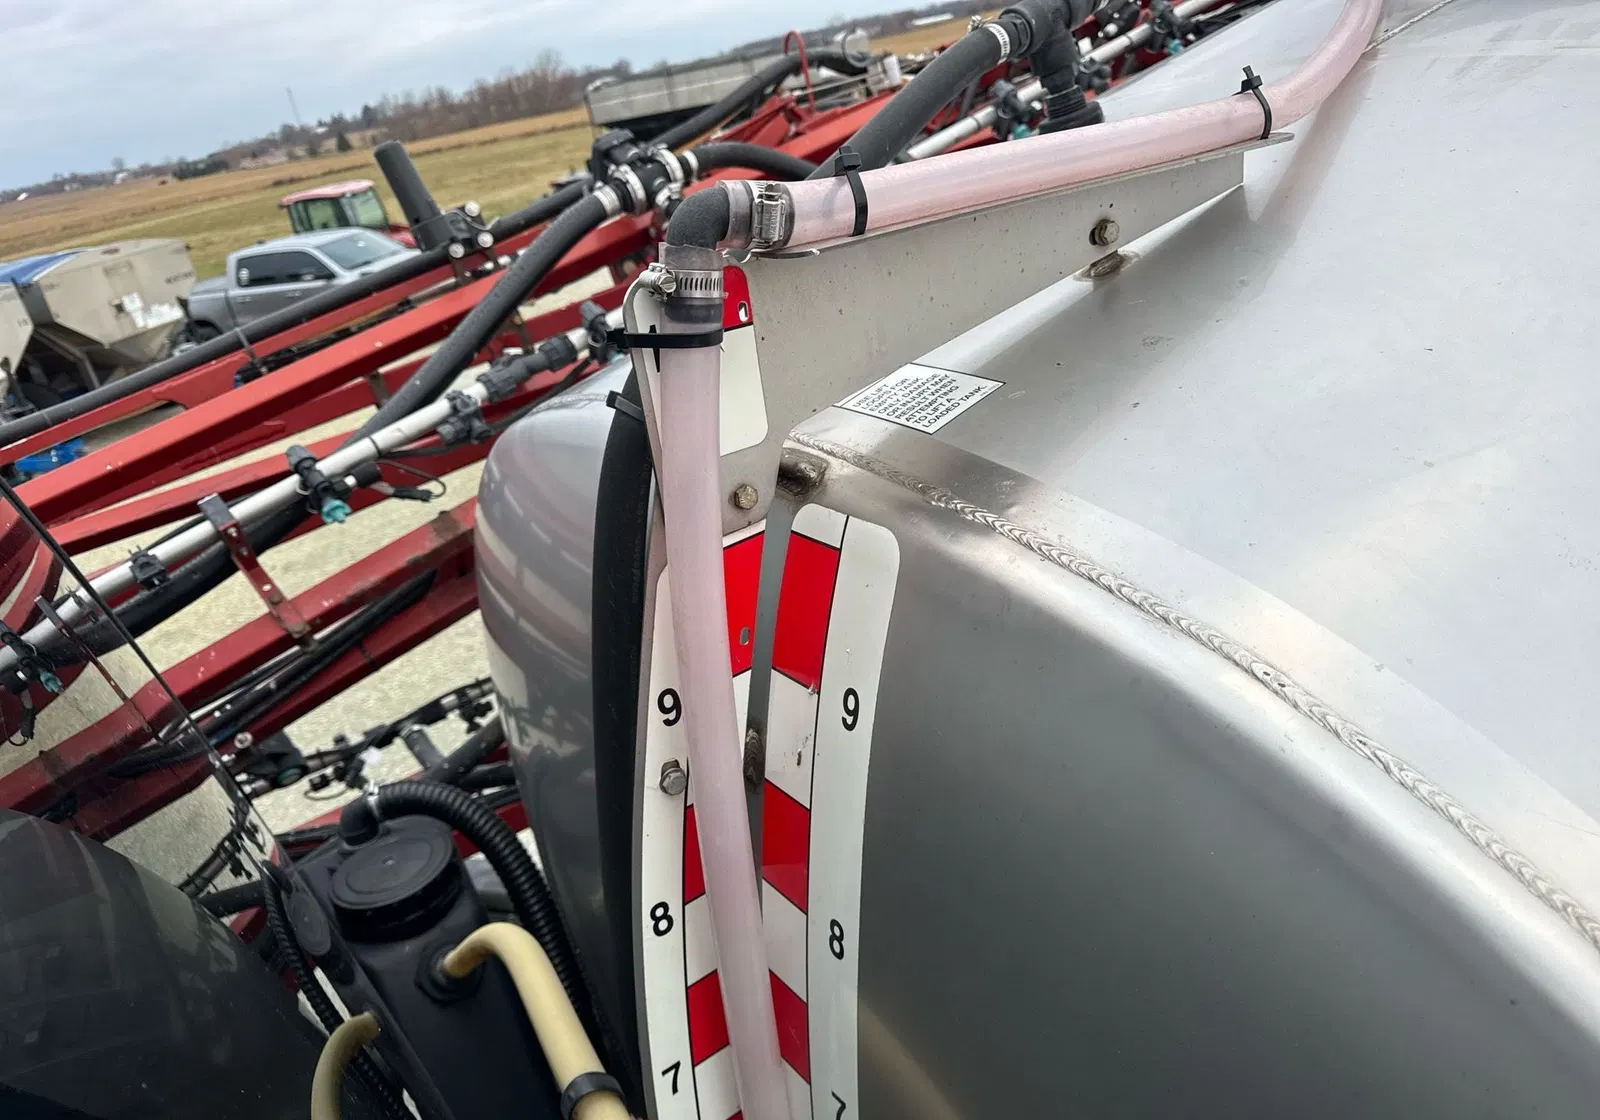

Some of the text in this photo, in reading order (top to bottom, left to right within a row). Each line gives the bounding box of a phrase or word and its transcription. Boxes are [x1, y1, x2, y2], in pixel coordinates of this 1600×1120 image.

[852, 384, 889, 407] USE LIFT
[861, 378, 911, 410] LOOPS FOR
[869, 378, 923, 412] EMPTY TANK
[887, 374, 950, 417] OR INJURY MAY
[895, 396, 930, 420] RESULT
[928, 378, 957, 397] WHEN
[902, 373, 941, 398] DAMAGE
[905, 385, 960, 423] ATTEMPTING
[912, 415, 928, 425] TO
[926, 402, 947, 416] LIFT
[923, 402, 961, 428] LOADED
[657, 687, 682, 727] 9
[841, 687, 860, 732] 9
[650, 901, 674, 937] 8
[828, 918, 845, 961] 8
[661, 1060, 681, 1096] 7
